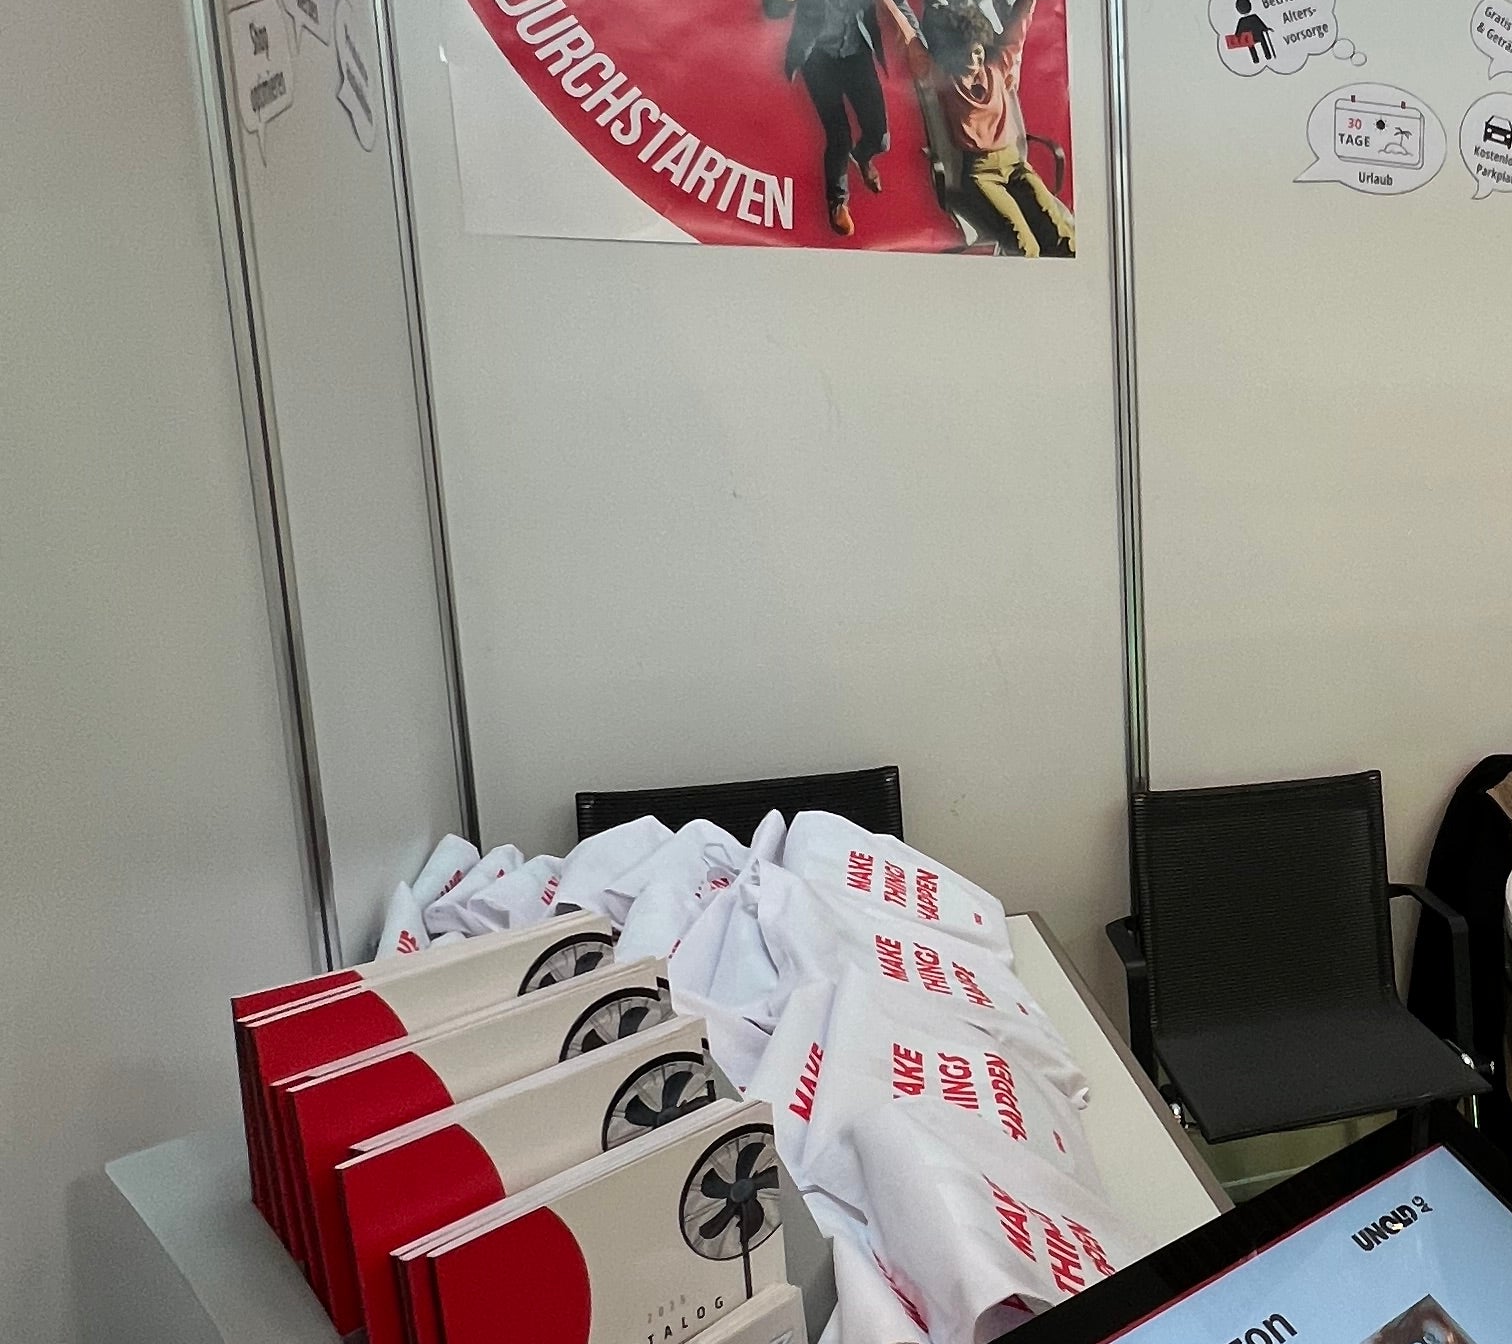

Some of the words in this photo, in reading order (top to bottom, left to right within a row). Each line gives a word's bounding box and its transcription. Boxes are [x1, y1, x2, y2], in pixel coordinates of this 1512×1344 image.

[1282, 6, 1317, 25] Alters-
[1484, 6, 1512, 32] Gratis
[1283, 22, 1329, 46] vorsorge
[1476, 22, 1485, 34] &
[1347, 117, 1362, 130] 30
[1338, 133, 1370, 147] TAGE
[1358, 171, 1393, 186] Urlaub
[847, 850, 874, 892] MAKE
[875, 934, 909, 982] MAKE
[913, 942, 953, 996] THINGS
[892, 1042, 925, 1100] AKE
